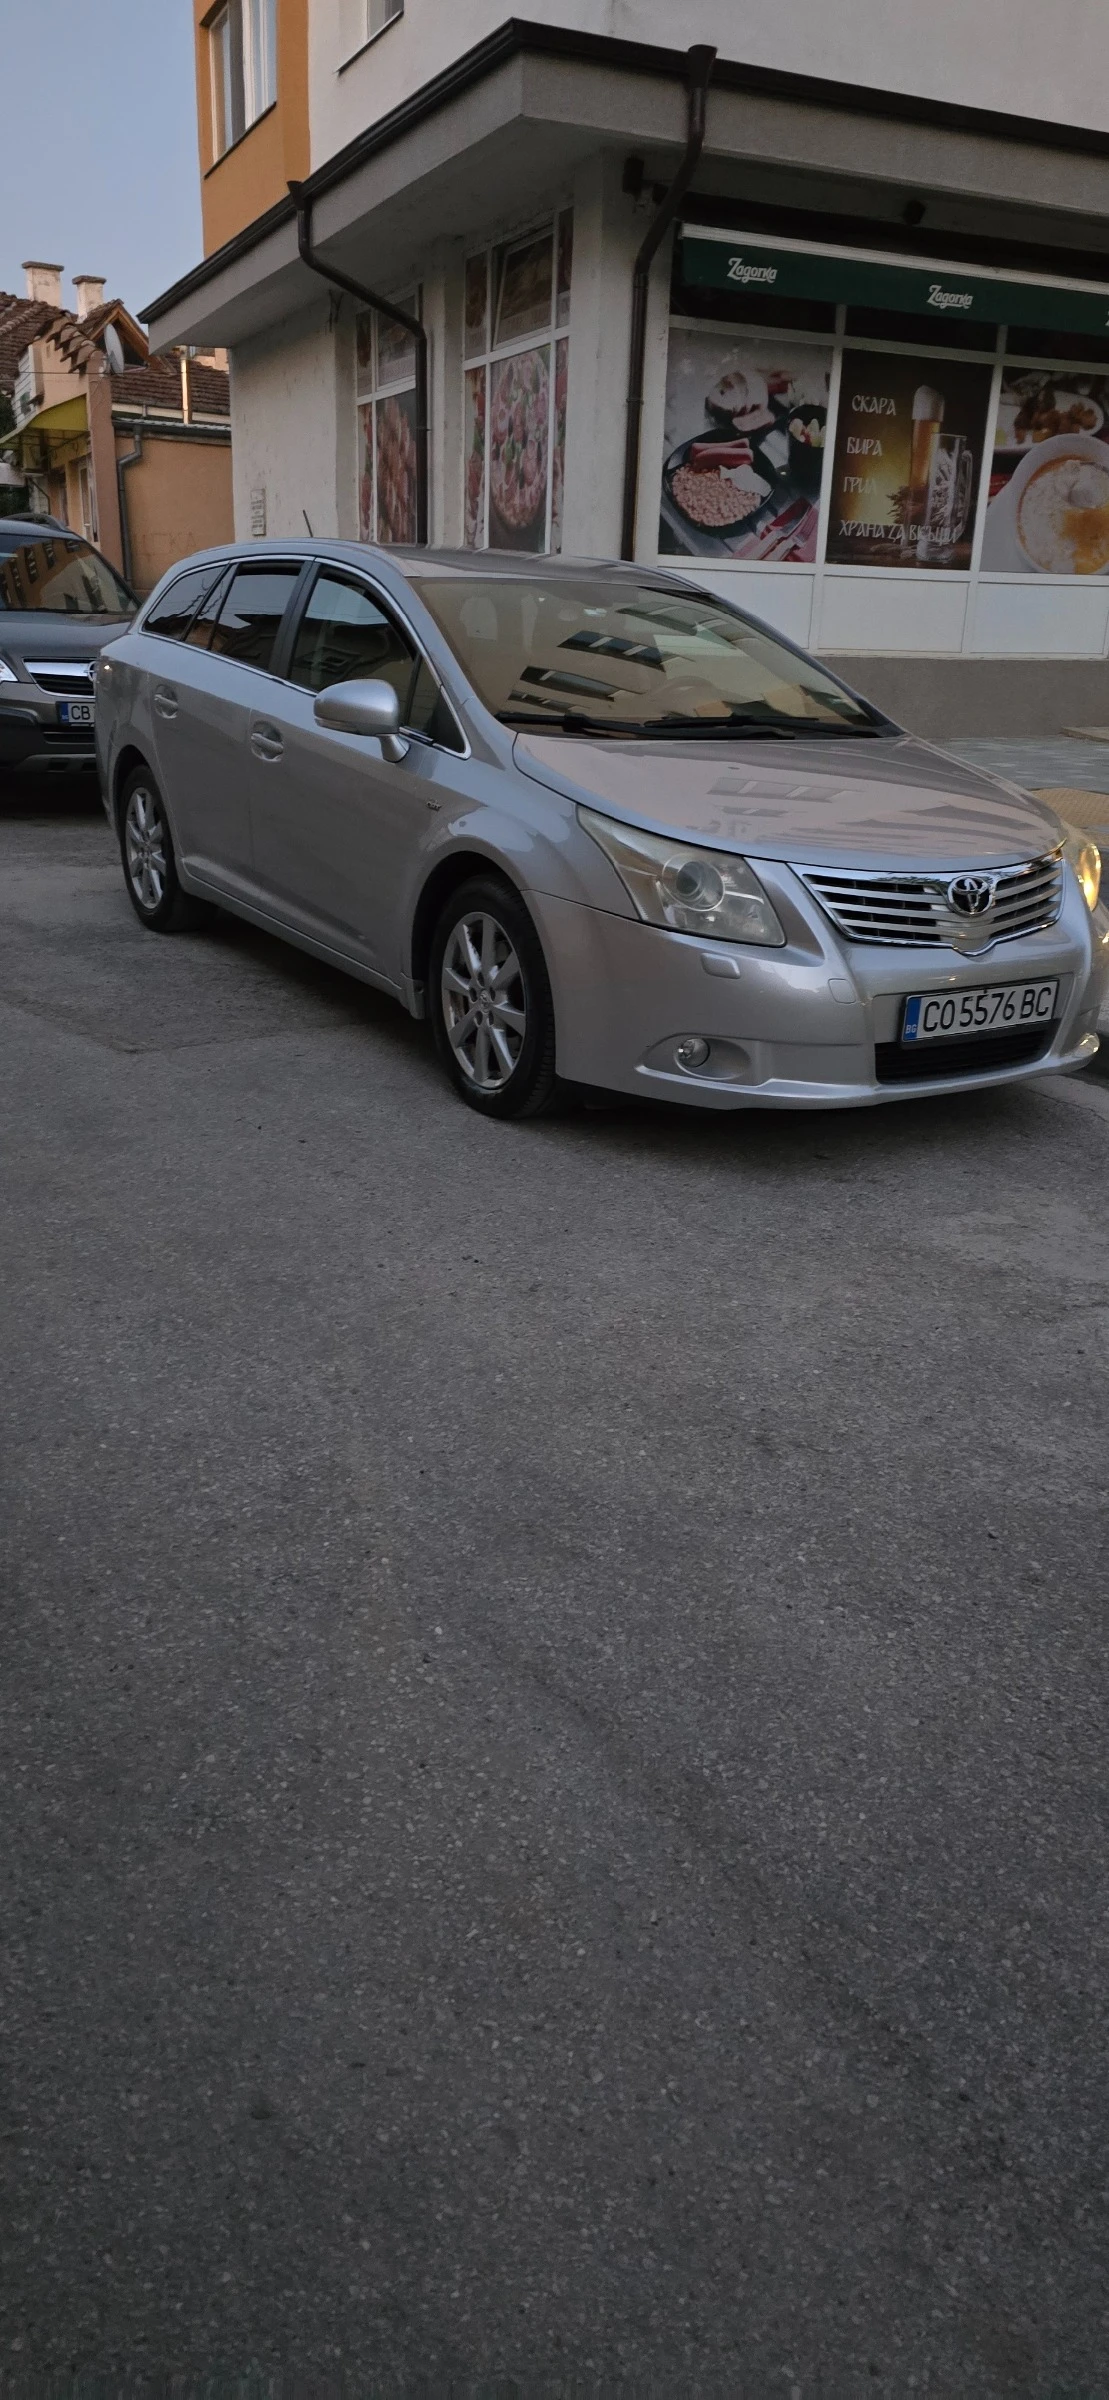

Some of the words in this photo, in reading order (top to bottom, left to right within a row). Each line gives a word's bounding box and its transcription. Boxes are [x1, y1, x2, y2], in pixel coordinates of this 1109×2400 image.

[727, 257, 778, 283] Zagorka
[927, 285, 974, 309] Zagorka
[851, 394, 897, 416] СКАРА
[846, 436, 883, 457] БИРА
[843, 476, 877, 494] ГРИЛ
[838, 519, 885, 539] ХРАНА
[71, 705, 91, 720] CB
[905, 1024, 917, 1035] BG
[923, 999, 956, 1032] CO
[959, 990, 1016, 1028] 5576
[1020, 987, 1052, 1019] BC
